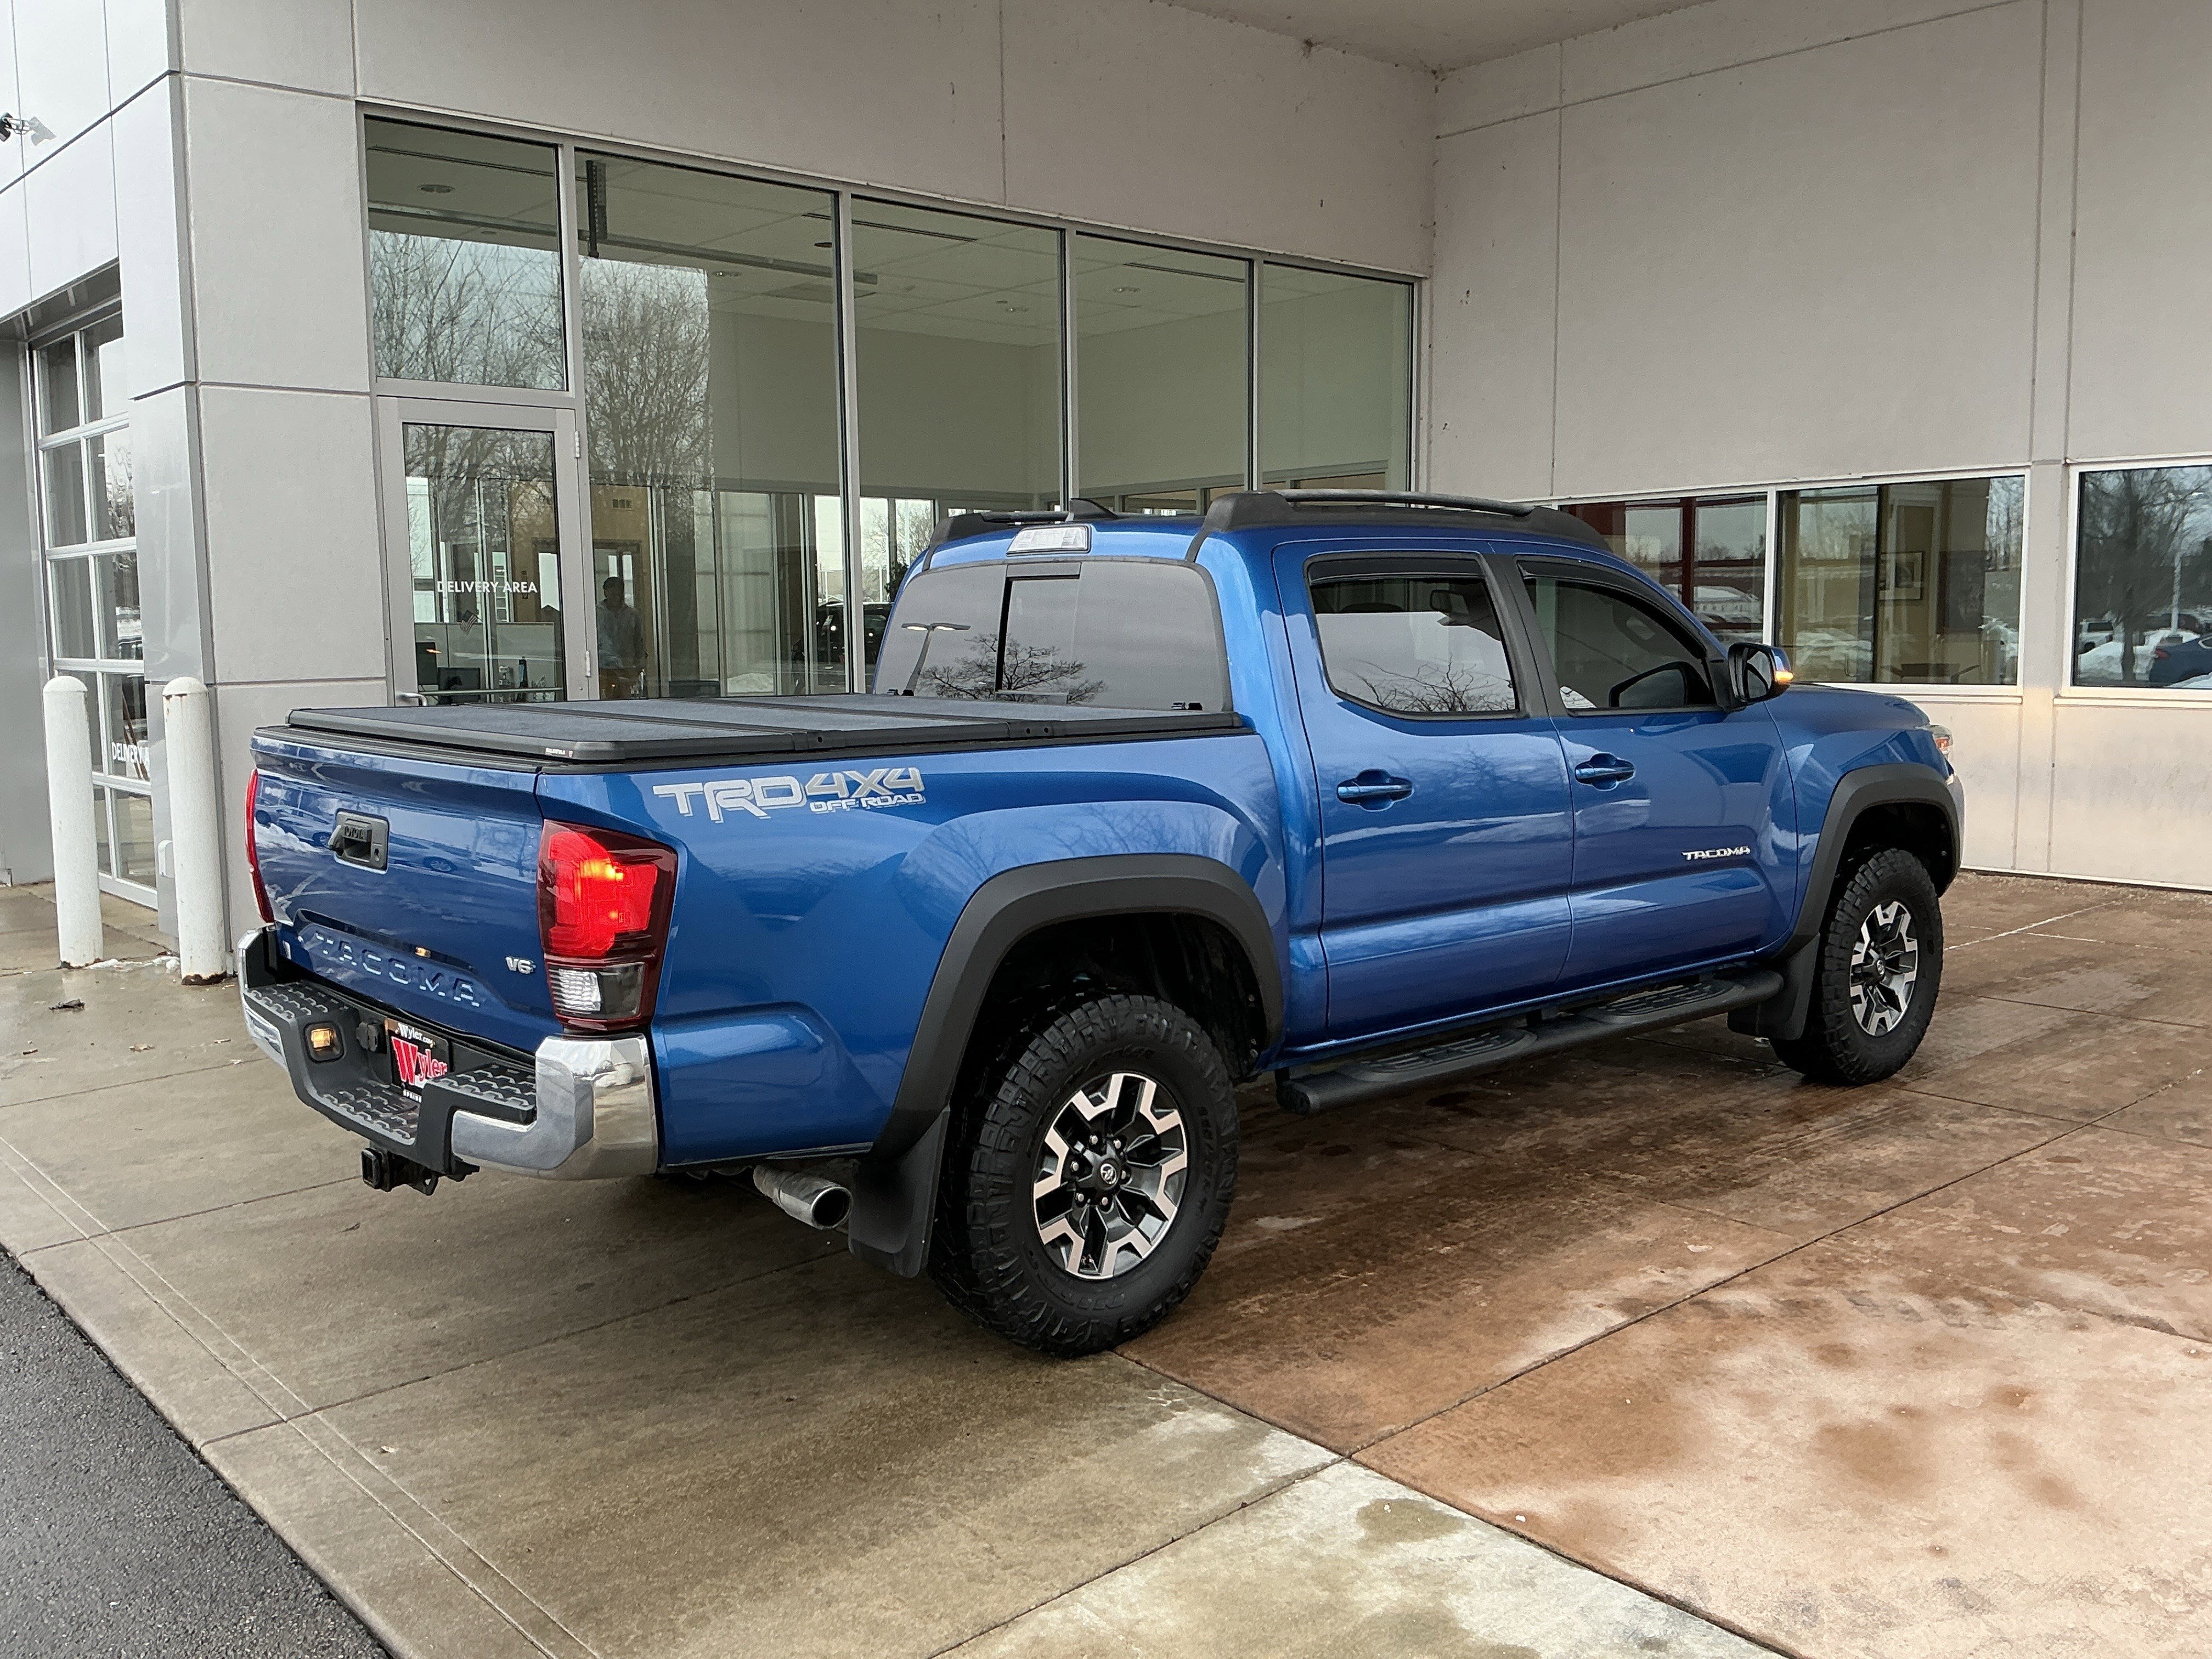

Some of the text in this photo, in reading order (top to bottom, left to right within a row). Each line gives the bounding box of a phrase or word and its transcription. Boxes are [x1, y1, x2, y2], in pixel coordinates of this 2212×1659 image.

[437, 581, 538, 593] DELIVERY AREA
[111, 742, 143, 764] DELIVERY
[653, 775, 809, 823] TRD
[1681, 845, 1751, 861] TACOMA
[314, 930, 481, 1008] TACOMA
[505, 956, 537, 975] V6
[391, 1036, 448, 1086] Wyler
